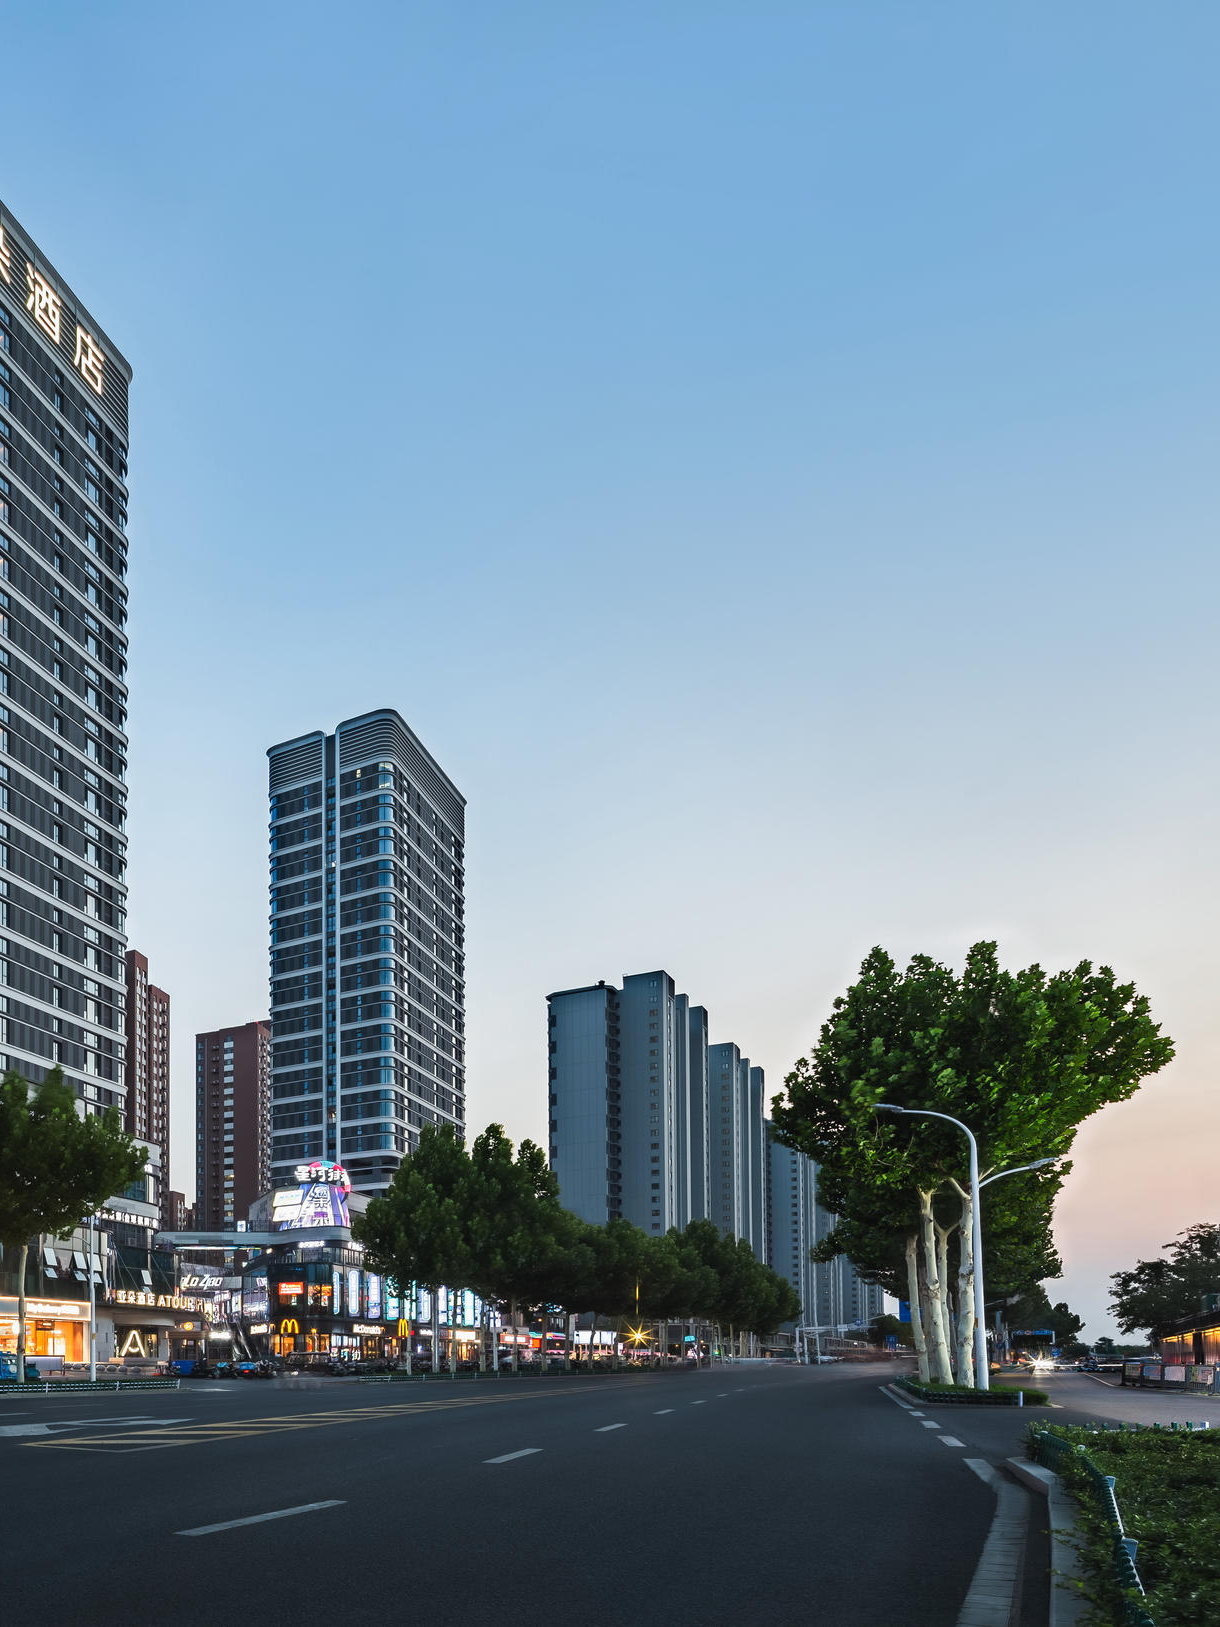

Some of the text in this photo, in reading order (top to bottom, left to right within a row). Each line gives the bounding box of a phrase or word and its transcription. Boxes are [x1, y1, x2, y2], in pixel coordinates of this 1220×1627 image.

[117, 1290, 155, 1305] 亚朵酒店
[157, 1295, 195, 1308] ATOUR
